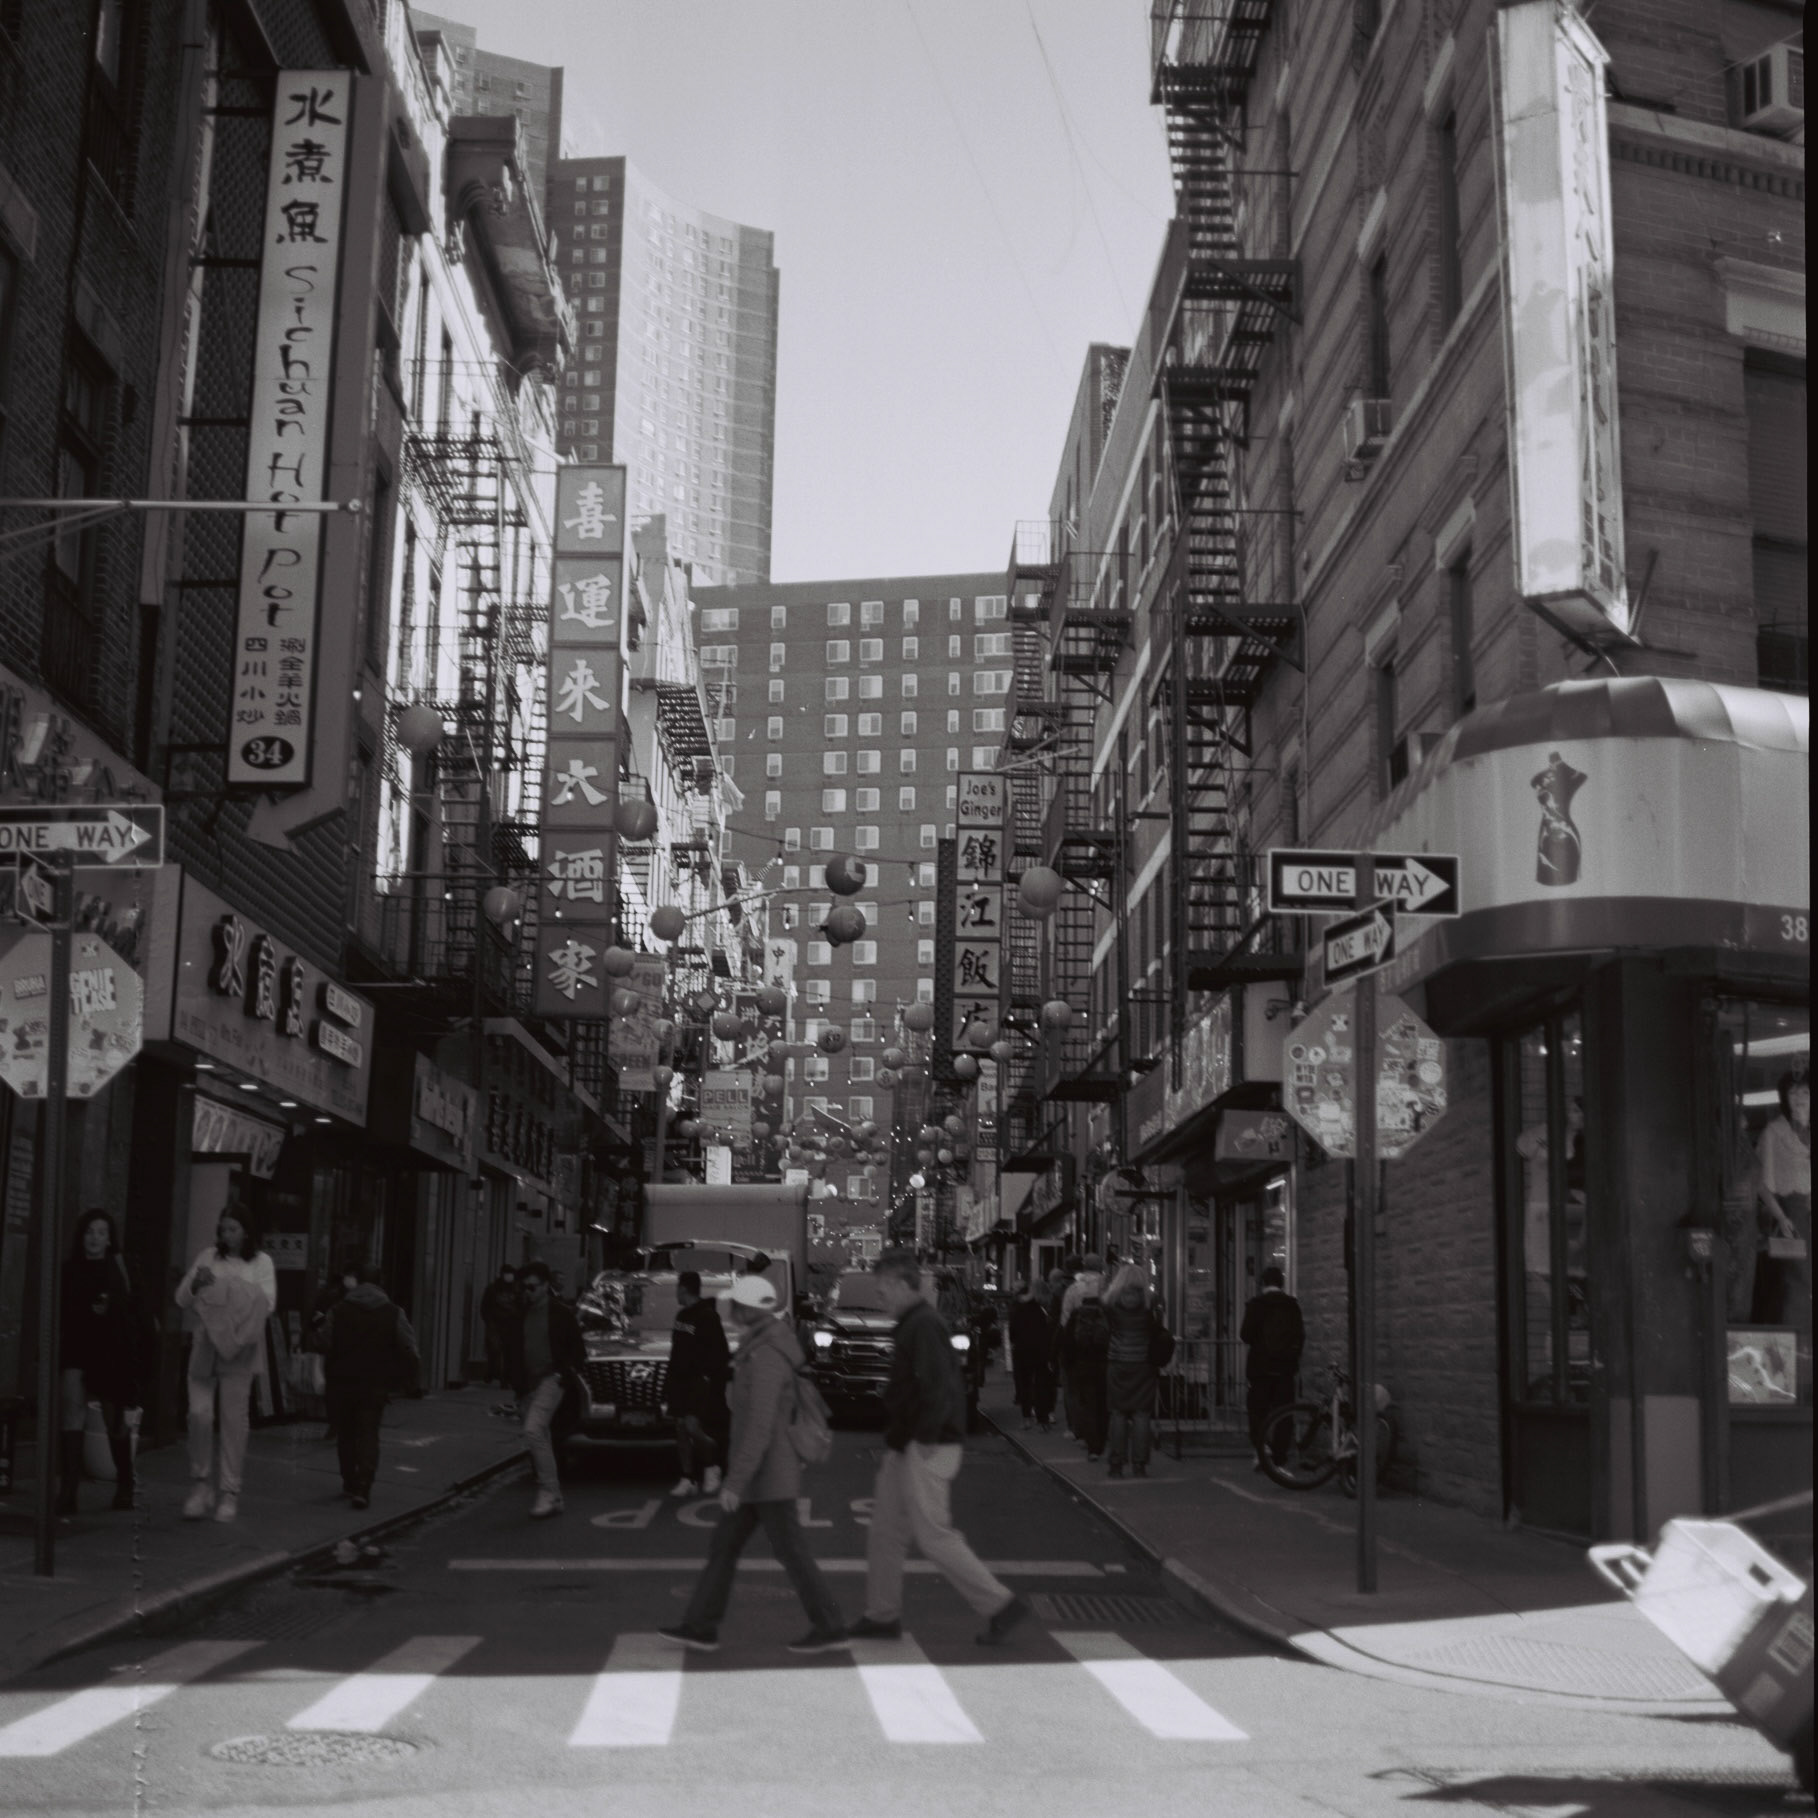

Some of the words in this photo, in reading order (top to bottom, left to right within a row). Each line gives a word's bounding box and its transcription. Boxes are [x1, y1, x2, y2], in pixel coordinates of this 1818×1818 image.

[276, 87, 342, 244] 水煮魚
[275, 265, 318, 437] Sichuan
[257, 548, 302, 628] Pot
[236, 637, 269, 725] 四川小炒
[248, 738, 284, 765] 34
[546, 481, 617, 1001] 喜運來大酒家
[965, 779, 997, 796] Joe's
[960, 799, 1002, 820] Ginger
[76, 825, 133, 849] WAY
[1298, 870, 1350, 894] ONE
[1376, 873, 1430, 897] WAY
[1780, 914, 1808, 942] 38
[1333, 936, 1354, 965] ONE
[1363, 925, 1386, 954] WAY
[703, 1089, 748, 1104] PELL
